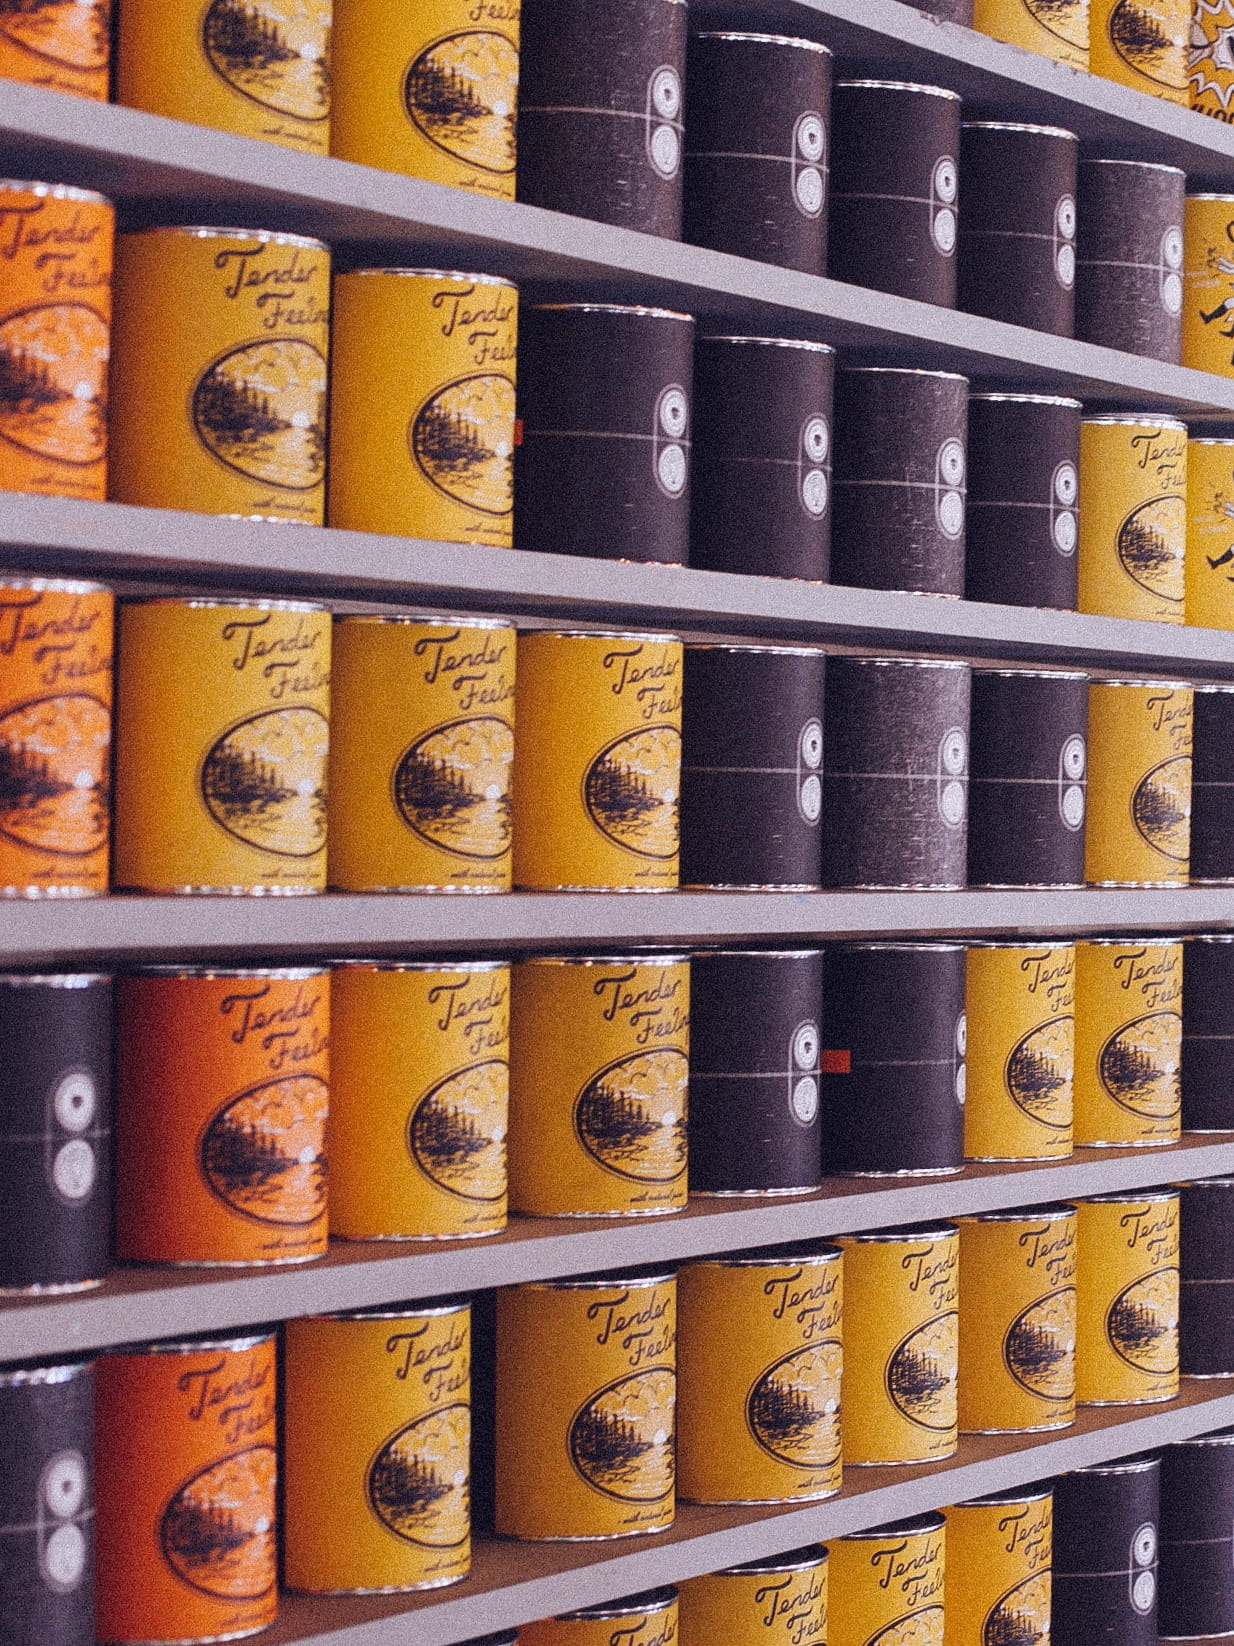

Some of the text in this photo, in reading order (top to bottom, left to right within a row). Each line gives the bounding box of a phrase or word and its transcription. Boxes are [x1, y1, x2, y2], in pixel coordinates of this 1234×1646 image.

[214, 243, 317, 298] Tender
[431, 284, 514, 337] Tender
[222, 614, 320, 670] Tender
[414, 630, 507, 683] Tender
[603, 644, 679, 694] Tender
[593, 968, 681, 1021] Tender
[1113, 947, 1178, 989] Tender
[220, 985, 320, 1043] Tender
[428, 976, 507, 1030] Tender
[587, 1290, 669, 1344] Tender
[764, 1268, 839, 1319] Tender
[386, 1321, 467, 1380] Tender
[871, 1540, 942, 1589] Tender
[755, 1574, 825, 1626] Tender
